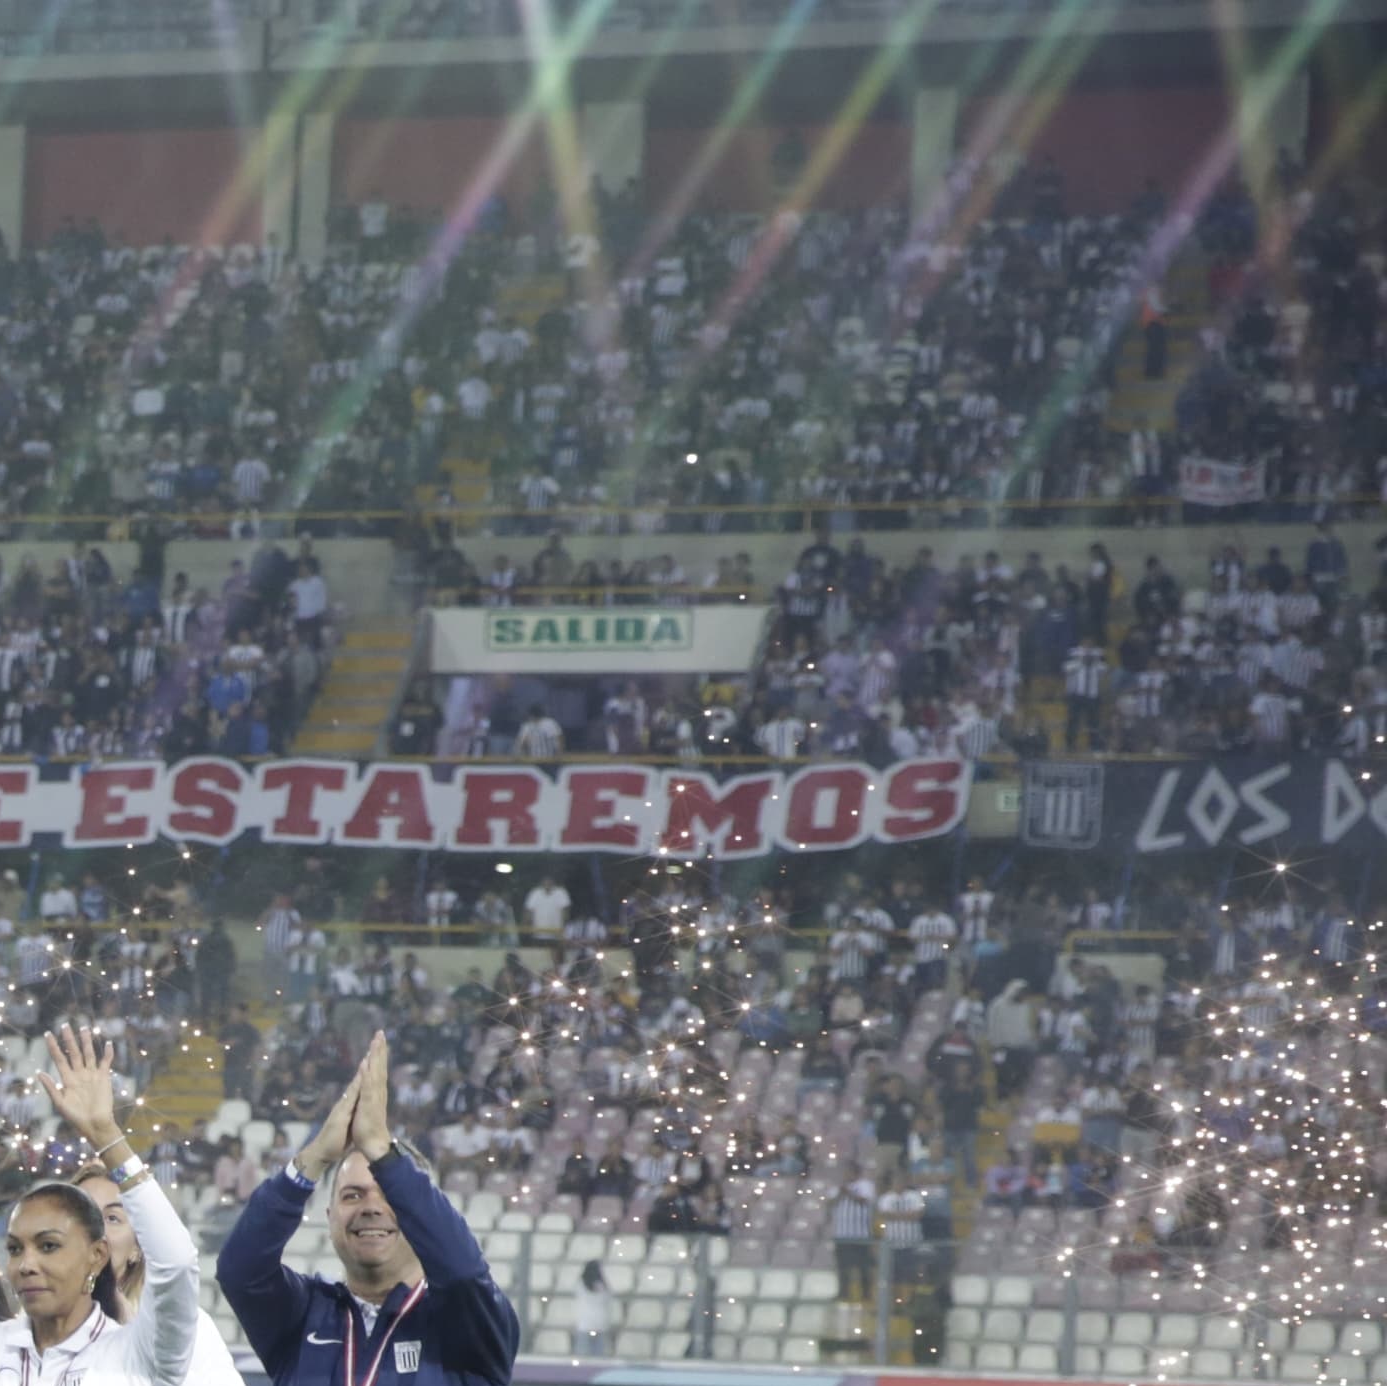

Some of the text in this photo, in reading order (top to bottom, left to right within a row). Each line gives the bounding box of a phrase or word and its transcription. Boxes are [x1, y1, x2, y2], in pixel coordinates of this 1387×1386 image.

[491, 612, 685, 648] SALIDA
[72, 759, 966, 852] ESTAREMOS
[1135, 762, 1291, 852] LOS
